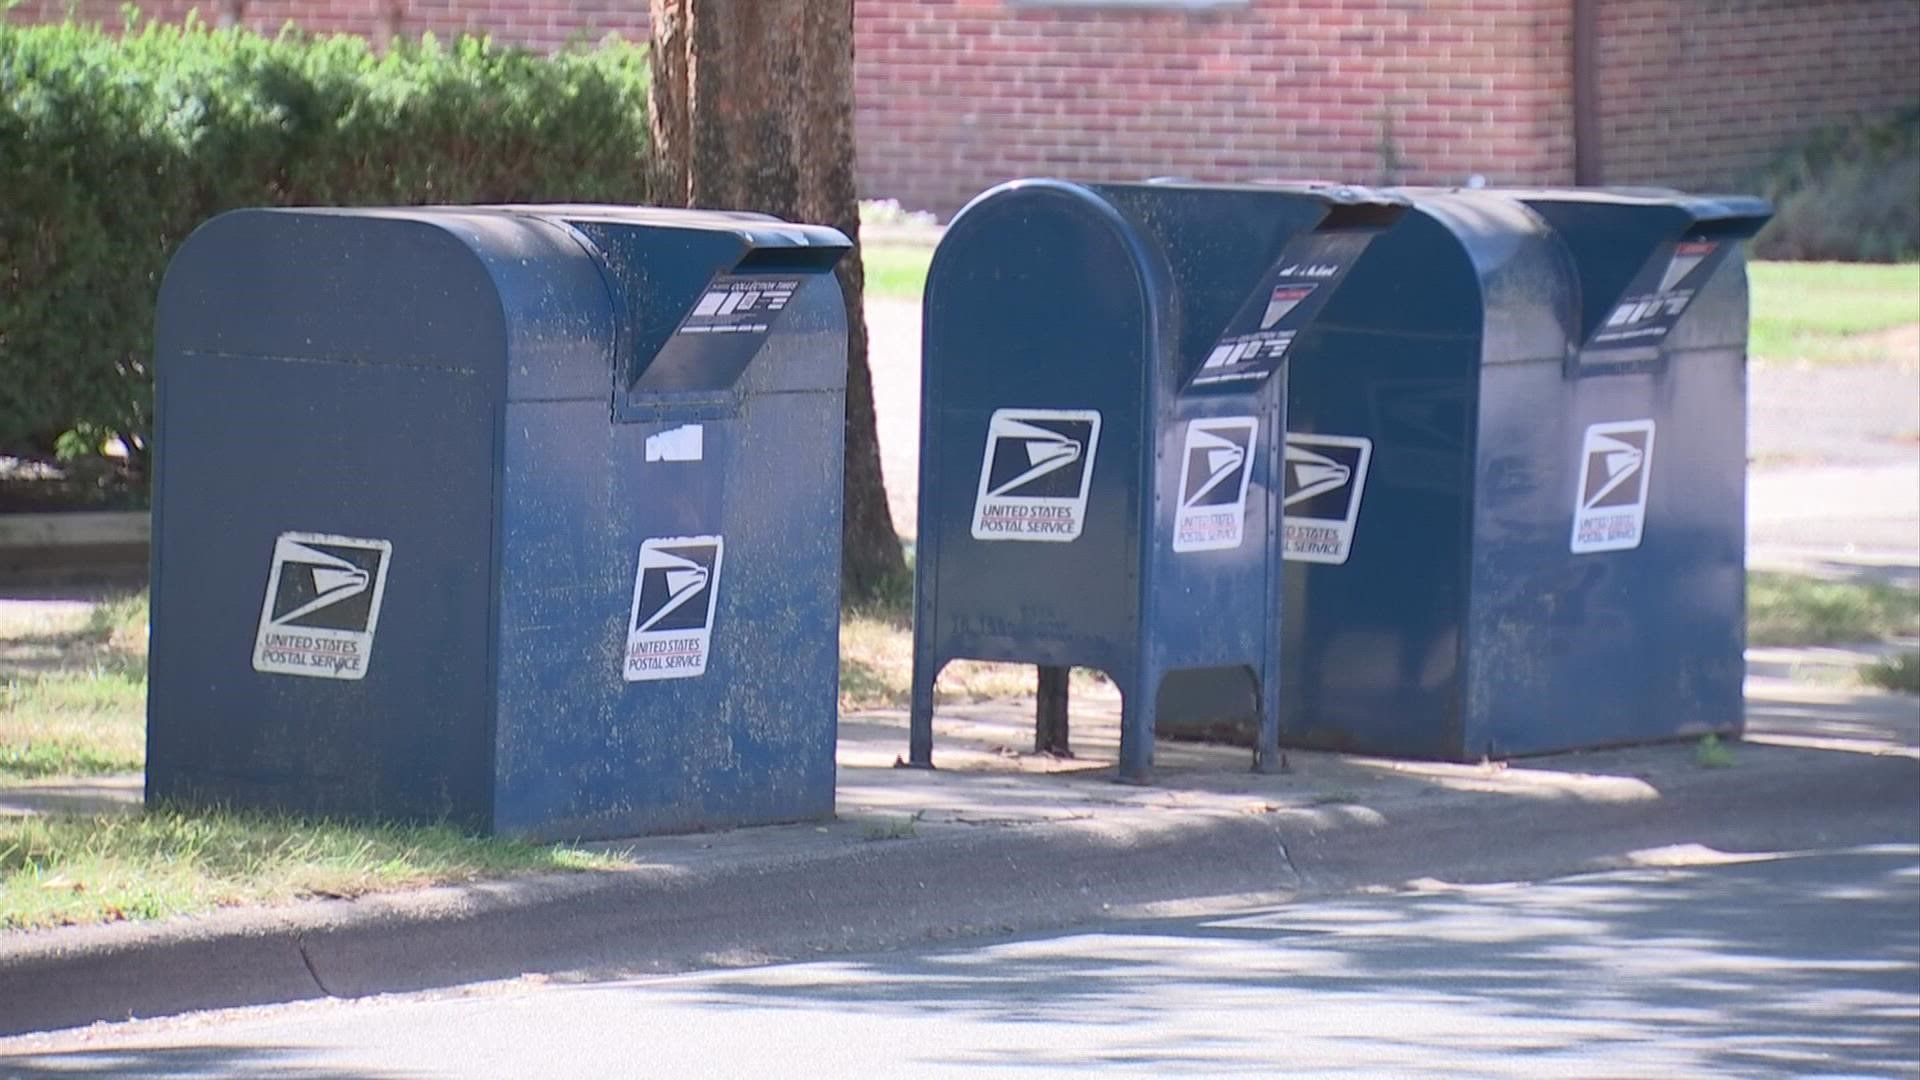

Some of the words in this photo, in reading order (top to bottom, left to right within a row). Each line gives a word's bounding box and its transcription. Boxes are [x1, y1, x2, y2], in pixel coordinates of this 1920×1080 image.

[983, 504, 1028, 516] UNITED
[1030, 506, 1072, 518] STATES
[980, 519, 1024, 532] POSTAL
[1027, 521, 1075, 534] SERVICE
[1297, 526, 1340, 540] STATES
[1294, 542, 1343, 555] SERVICE
[265, 633, 313, 649] UNITED
[315, 639, 358, 653] STATES
[631, 640, 667, 655] UNITED
[667, 638, 700, 651] STATES
[262, 650, 307, 666] POSTAL
[311, 655, 361, 671] SERVICE
[628, 656, 664, 671] POSTAL
[664, 654, 701, 668] SERVICE
